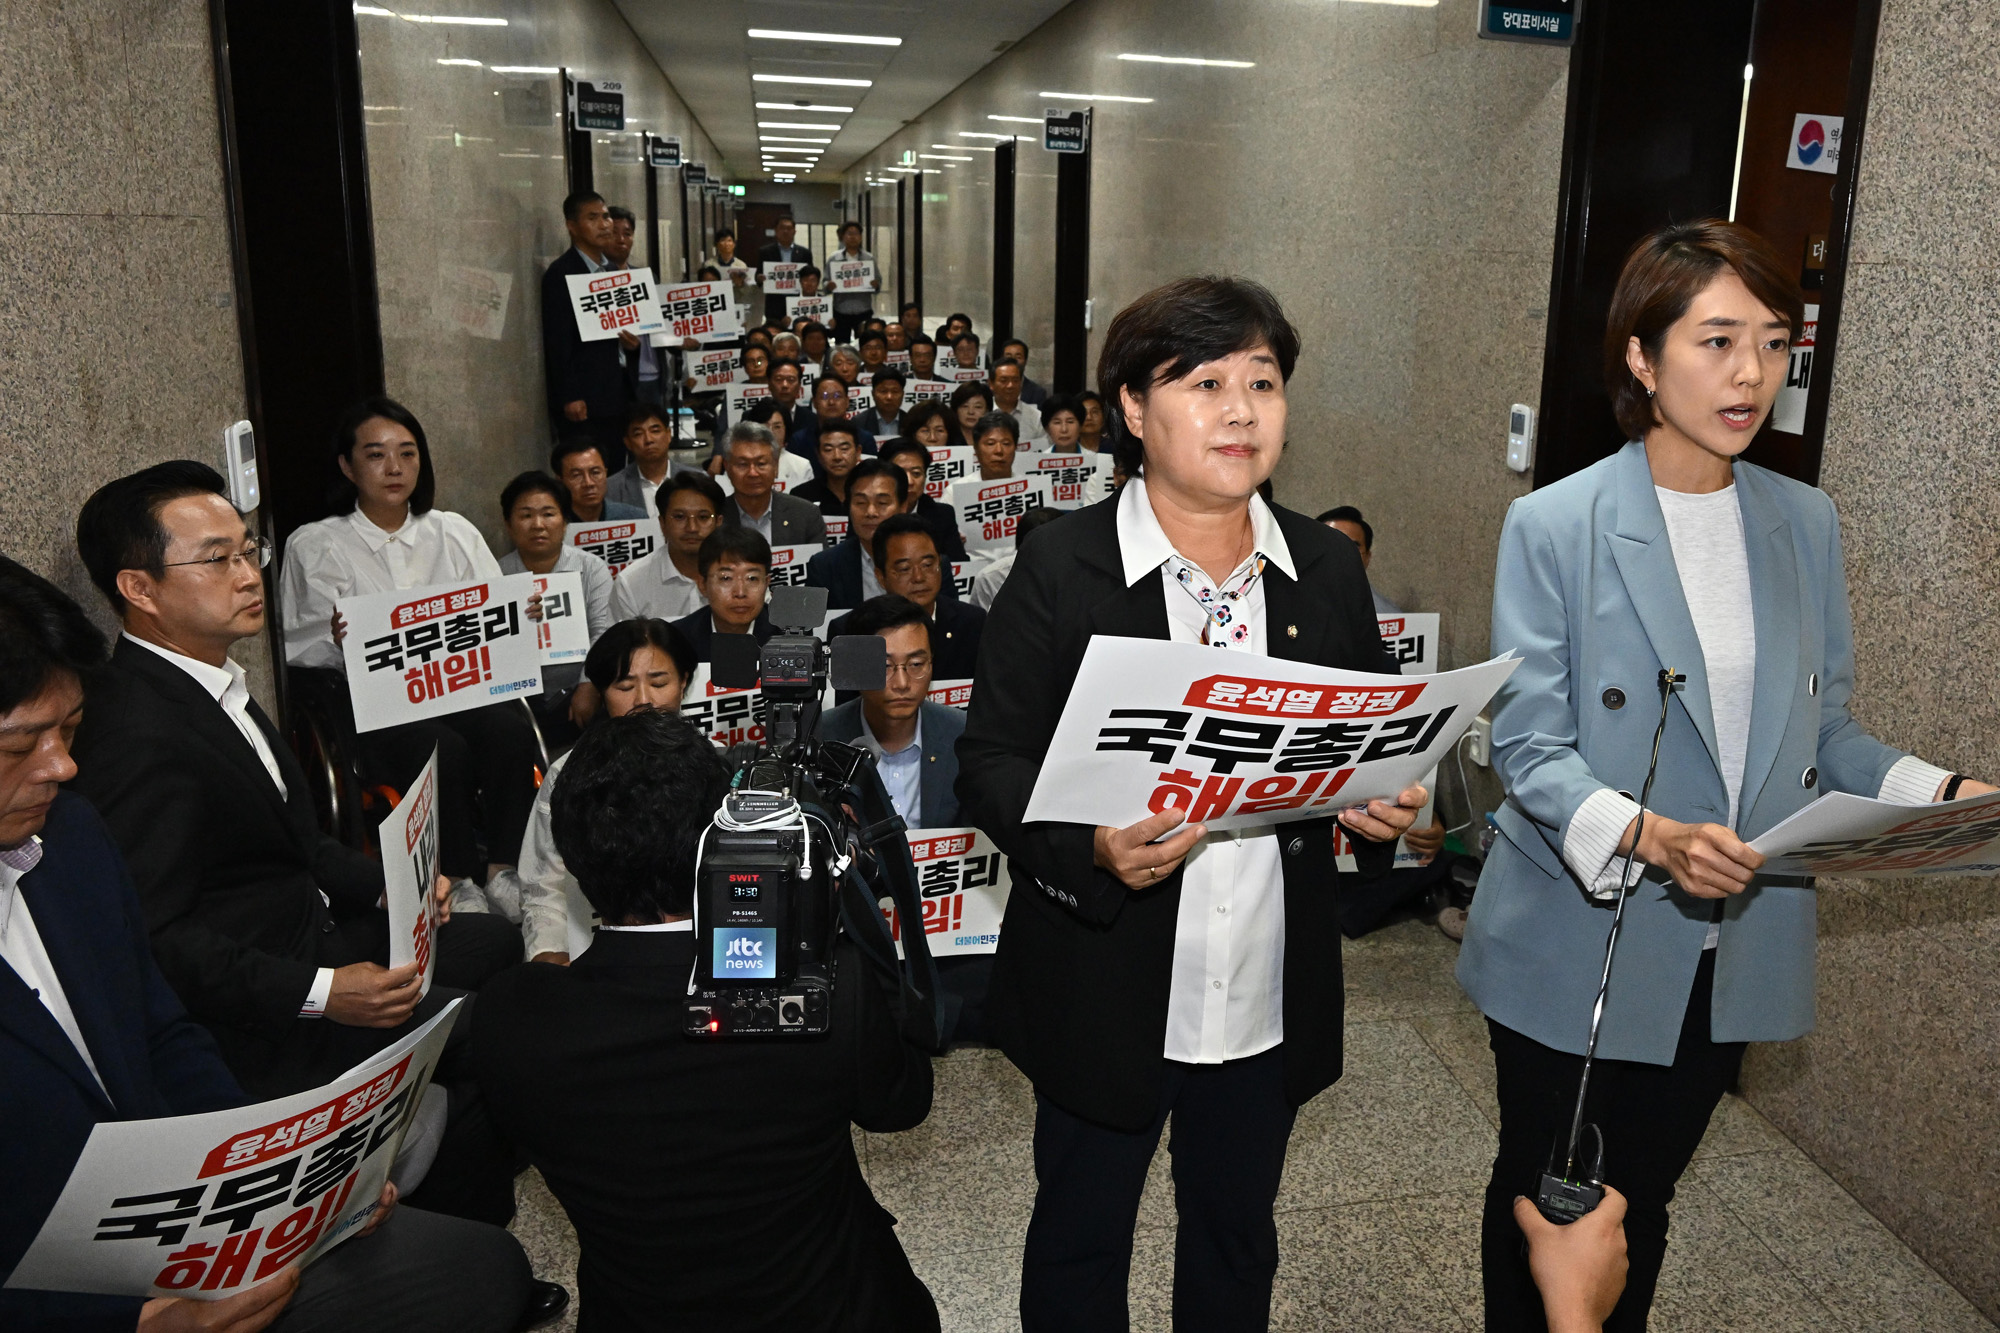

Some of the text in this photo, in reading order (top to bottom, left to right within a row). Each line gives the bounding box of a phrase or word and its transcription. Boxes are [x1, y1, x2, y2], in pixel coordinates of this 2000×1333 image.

[1503, 12, 1560, 33] 당대표비서실
[603, 82, 622, 90] 209
[835, 267, 870, 279] 국무총리
[579, 282, 650, 314] 국무총리
[660, 294, 727, 321] 국무총리
[599, 304, 641, 331] 해임!
[672, 314, 715, 337] 해임!
[706, 371, 734, 386] 해임!
[928, 460, 965, 482] 총리
[982, 482, 1025, 498] 윤석열 정권
[1052, 484, 1081, 501] 임!
[964, 490, 1044, 523] 국무총리
[579, 525, 631, 543] 윤석열 정권
[982, 515, 1021, 541] 해임
[769, 562, 808, 587] 총리
[397, 589, 482, 623] 윤석열 정권
[364, 601, 520, 673] 국무총리
[404, 645, 493, 705] 해임!
[489, 678, 537, 696] 더불어민주당
[1206, 681, 1406, 715] 윤석열 정권
[1095, 704, 1459, 775] 국무총리
[1147, 767, 1357, 824] 해임!
[934, 837, 967, 853] 정권
[729, 874, 760, 882] SWIT
[914, 851, 1001, 899] 총리
[955, 934, 1000, 946] 더불어민주
[726, 959, 764, 969] news
[222, 1067, 401, 1169] 윤석열 정권
[93, 1062, 429, 1246] 국무총리
[153, 1167, 361, 1292] 해임!
